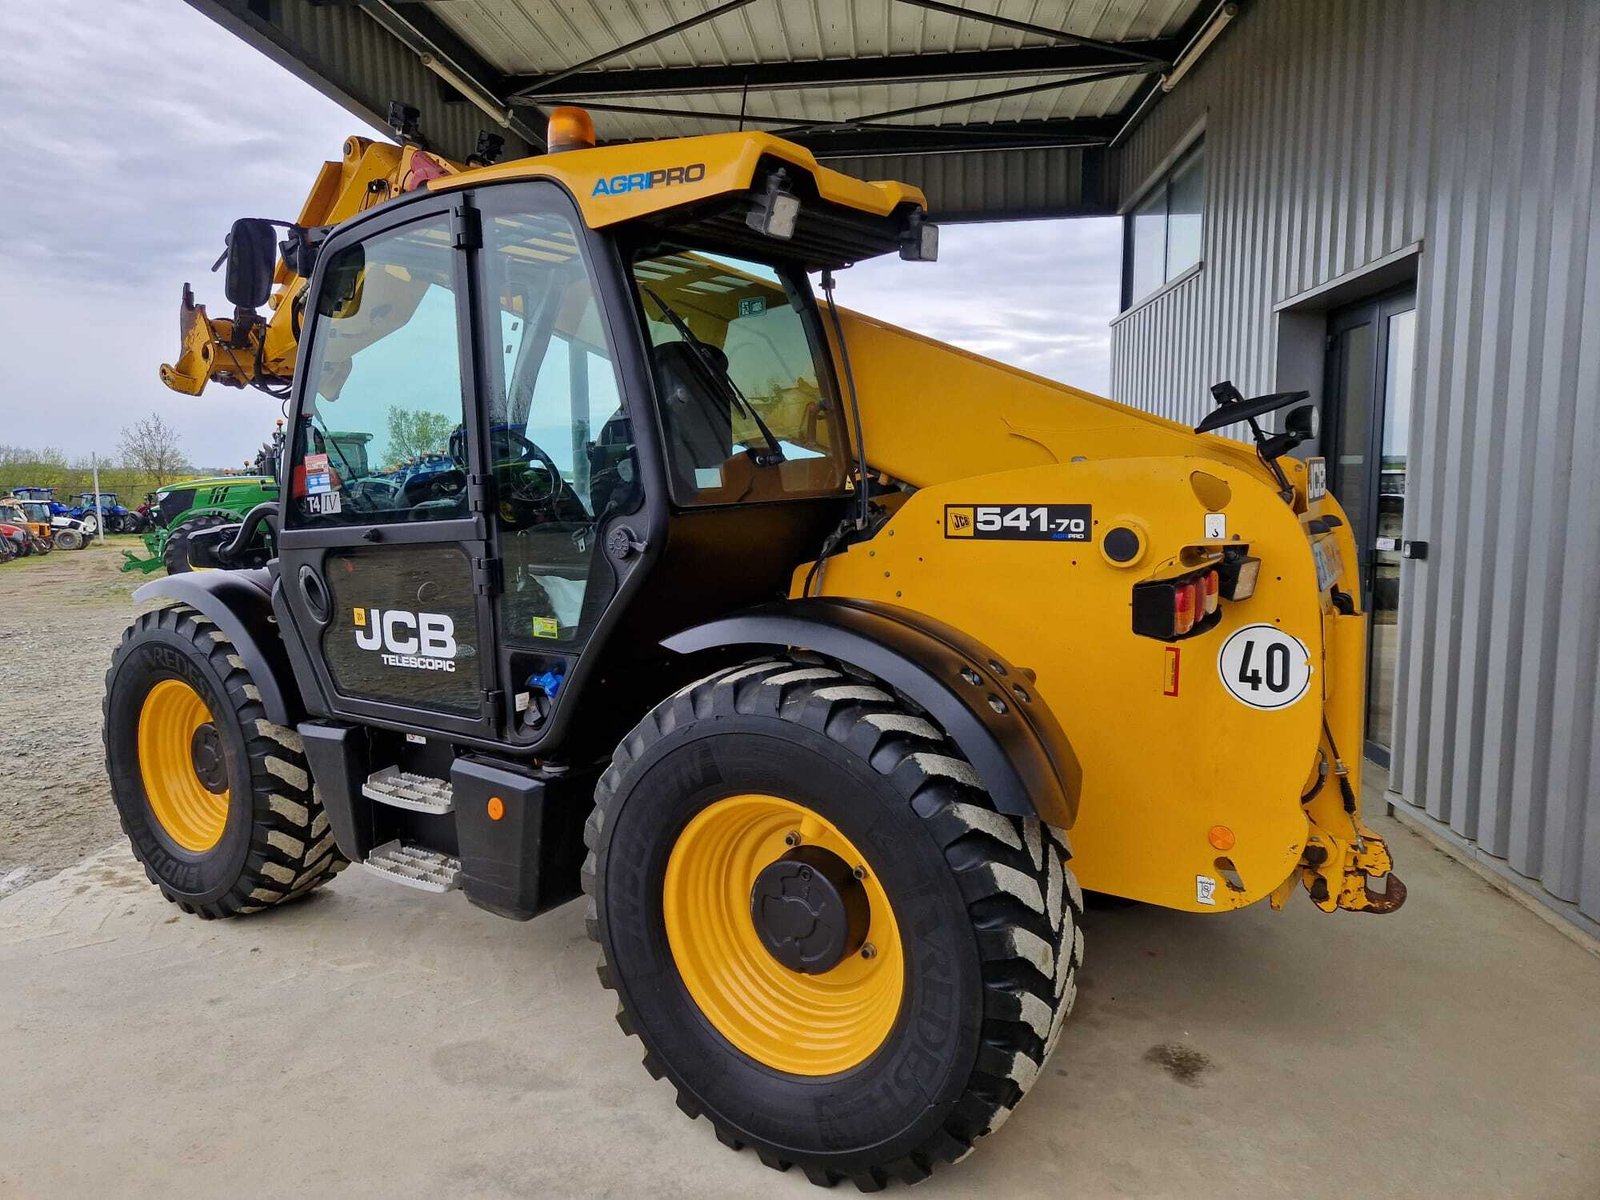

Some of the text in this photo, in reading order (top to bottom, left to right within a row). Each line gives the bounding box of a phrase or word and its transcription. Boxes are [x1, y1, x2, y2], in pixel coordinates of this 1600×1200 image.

[592, 163, 706, 197] AGRIPRO
[307, 494, 337, 512] T4 IV
[953, 507, 1085, 532] JCB 541-70
[355, 608, 457, 659] JCB
[381, 654, 456, 673] TELESCOPIC
[1239, 641, 1291, 693] 40
